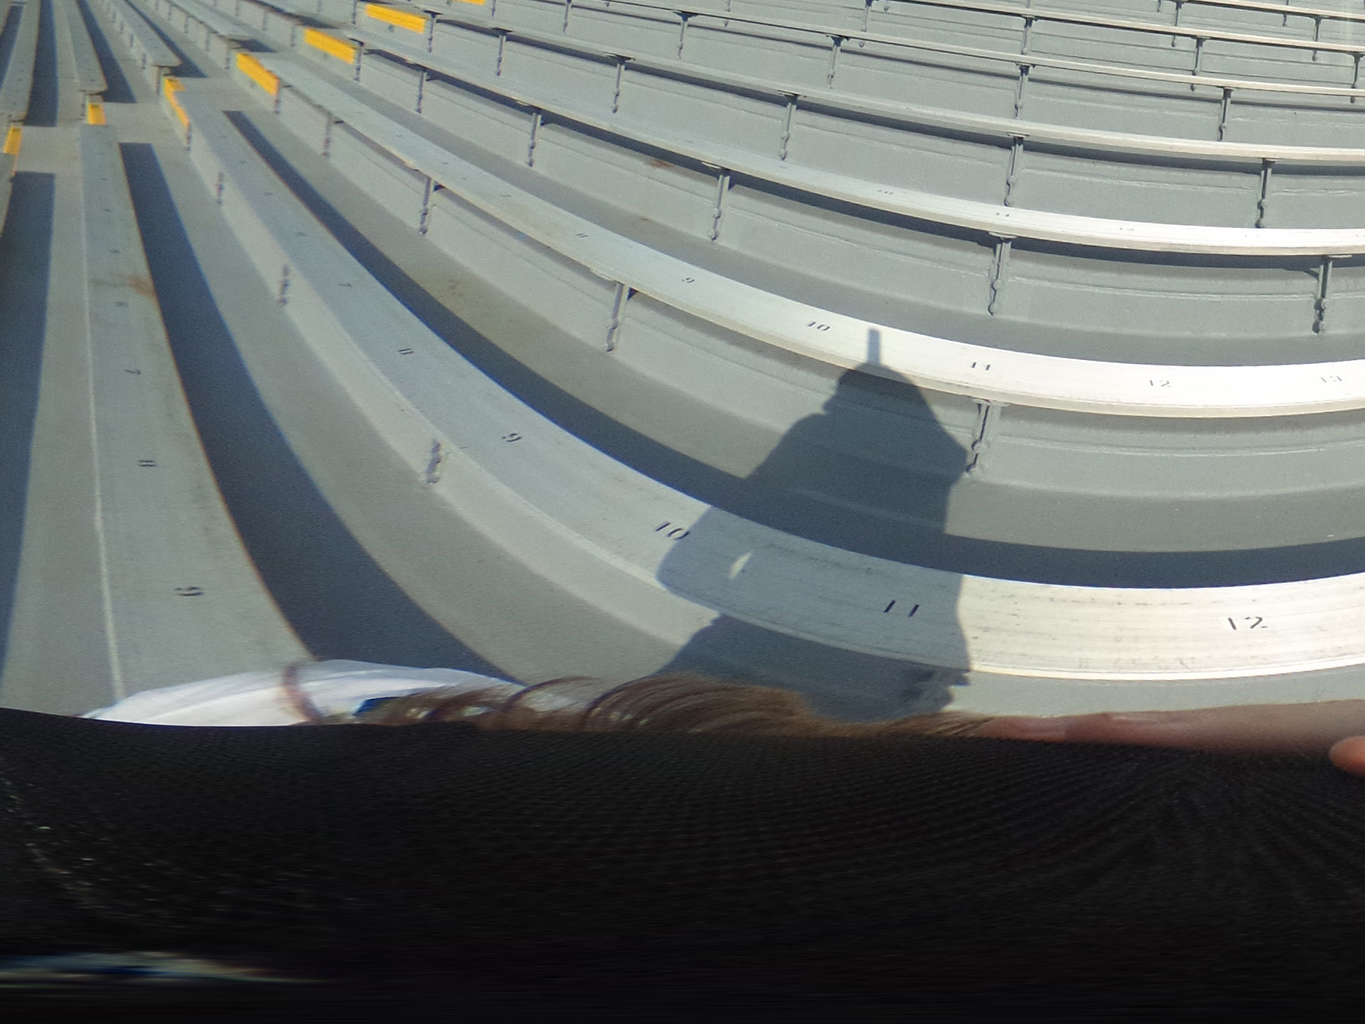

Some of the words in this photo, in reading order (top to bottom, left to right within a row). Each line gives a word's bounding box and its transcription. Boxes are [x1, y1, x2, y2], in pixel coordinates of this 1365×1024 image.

[806, 320, 833, 332] 10
[971, 361, 993, 372] 11
[1149, 379, 1173, 388] 12
[1319, 375, 1345, 384] 13
[501, 431, 524, 443] 9
[654, 521, 691, 541] 10
[882, 599, 922, 618] 11
[1227, 616, 1270, 632] 12
